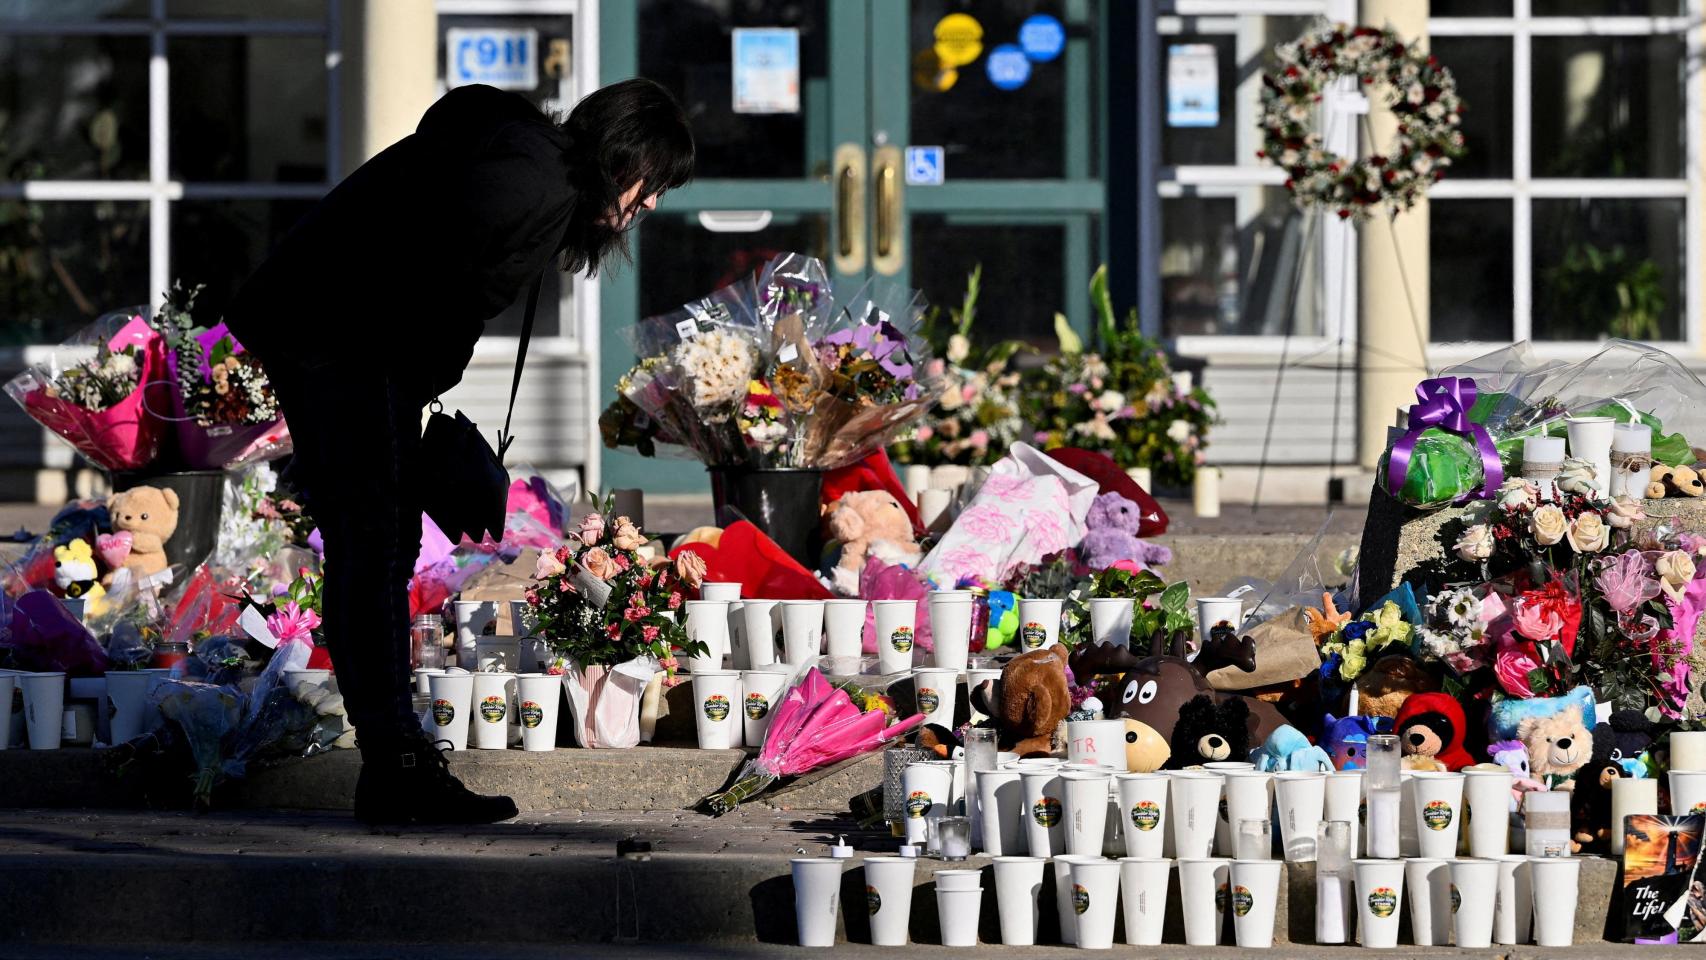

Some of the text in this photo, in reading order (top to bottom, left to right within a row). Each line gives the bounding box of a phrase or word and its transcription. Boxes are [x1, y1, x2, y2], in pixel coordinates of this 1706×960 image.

[478, 37, 527, 65] 911
[1635, 885, 1660, 899] The
[1632, 898, 1666, 921] Life!
